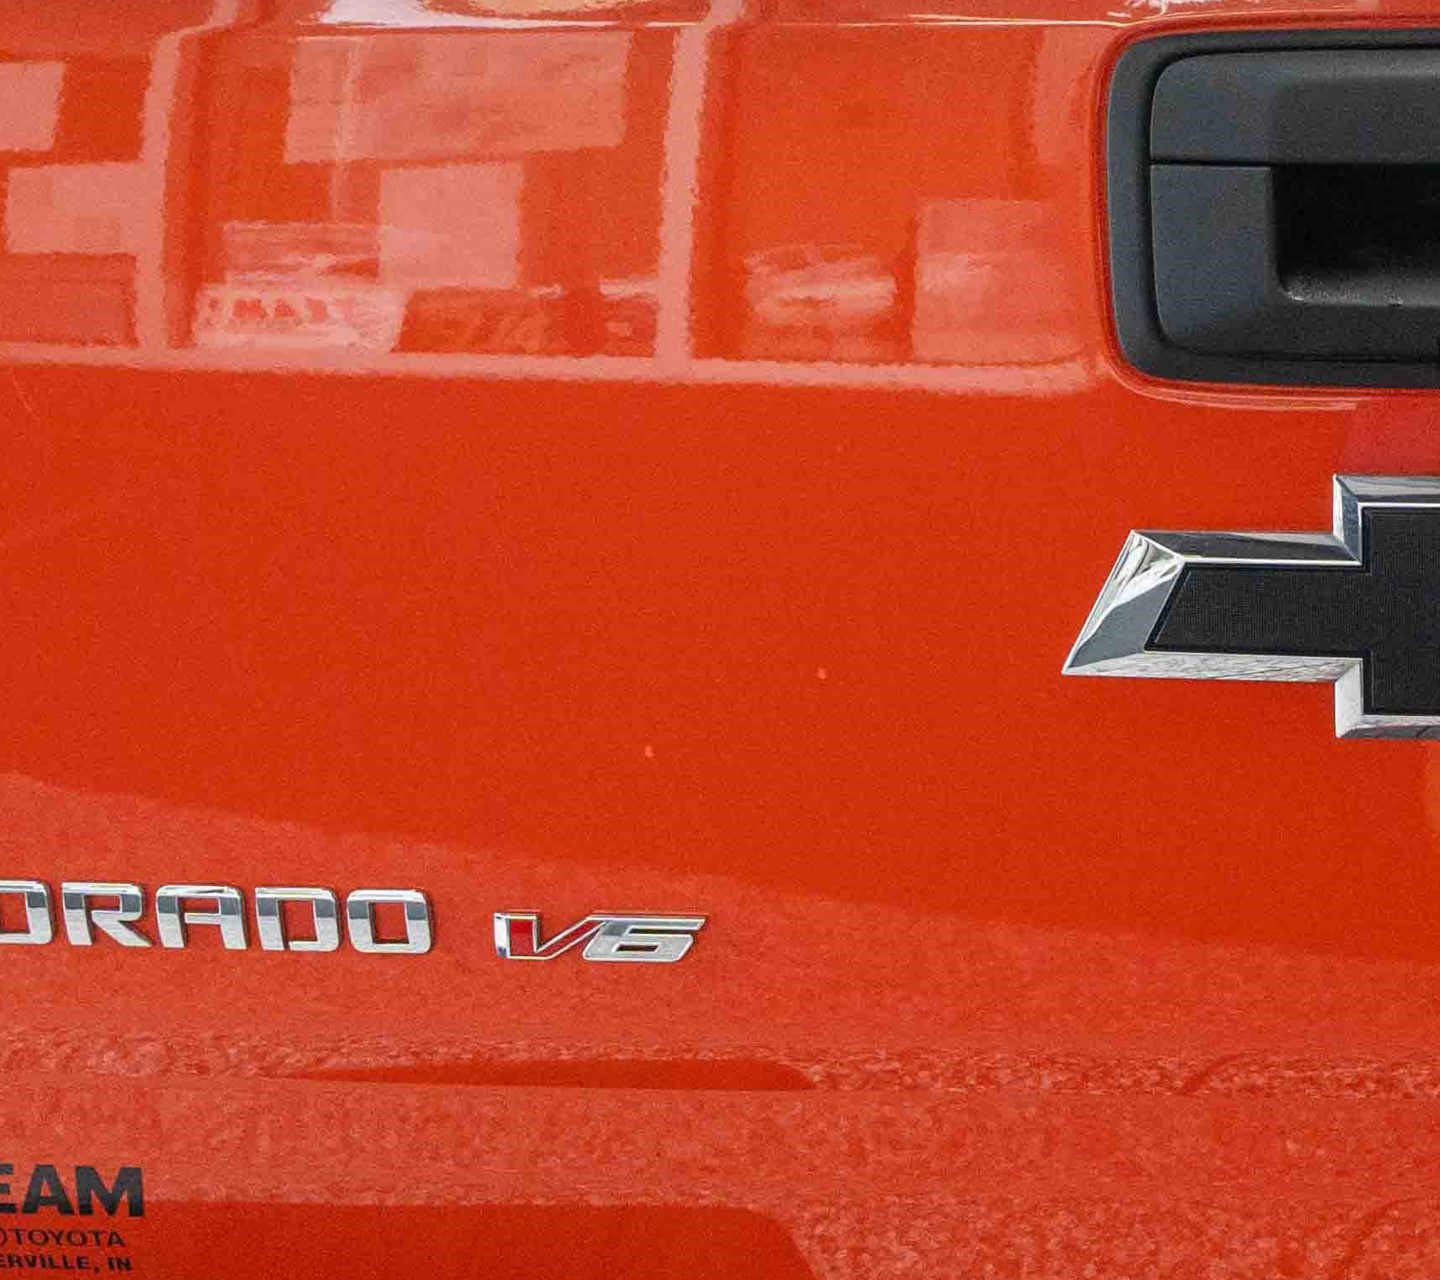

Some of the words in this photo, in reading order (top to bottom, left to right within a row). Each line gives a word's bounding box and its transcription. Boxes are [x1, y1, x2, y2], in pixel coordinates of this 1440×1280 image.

[495, 911, 707, 961] V6
[10, 1227, 126, 1248] TOYOTA
[107, 1256, 133, 1271] IN
